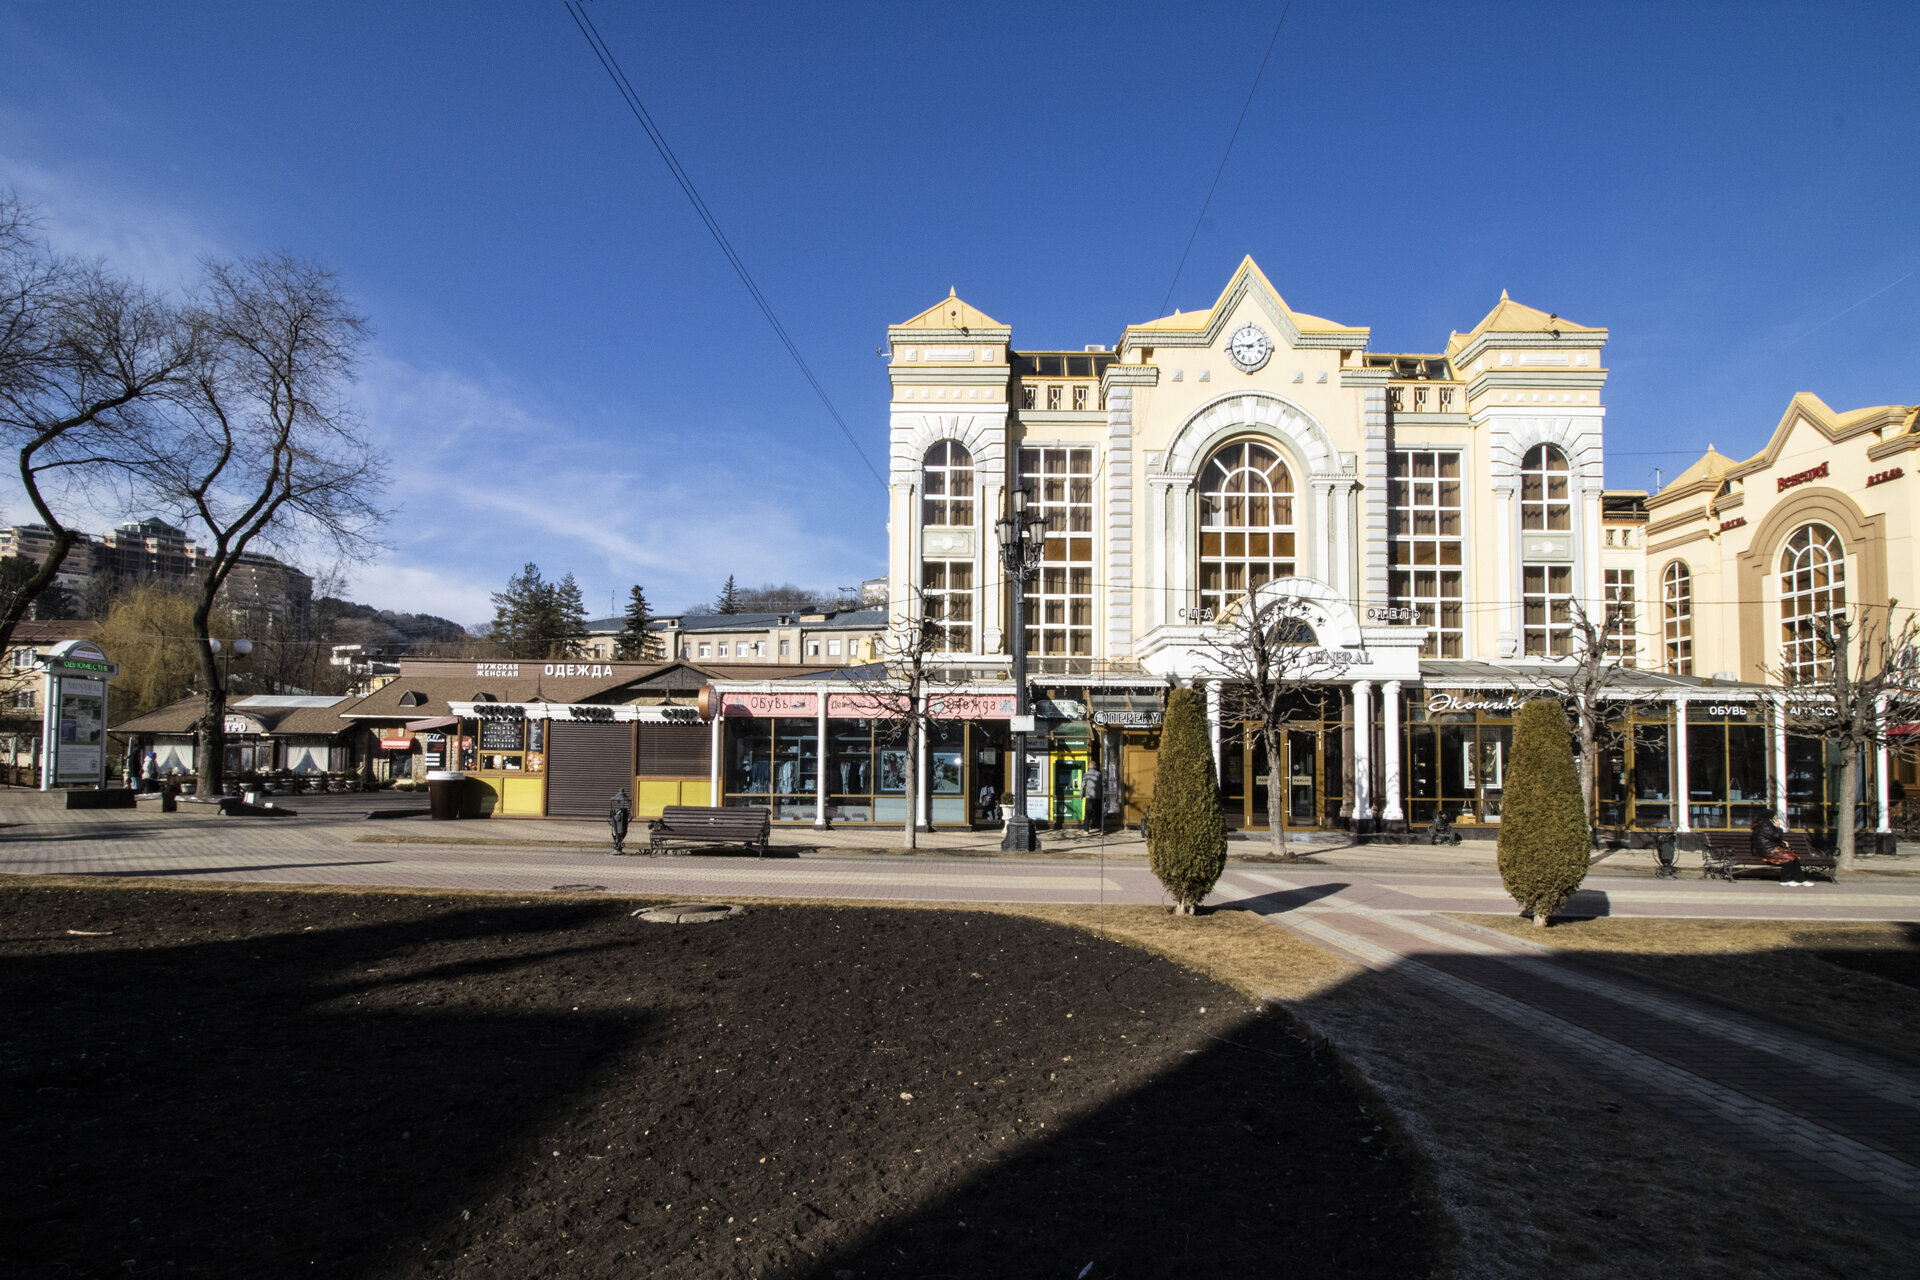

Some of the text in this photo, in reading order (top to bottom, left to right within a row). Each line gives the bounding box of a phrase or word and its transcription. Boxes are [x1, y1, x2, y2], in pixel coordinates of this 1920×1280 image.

[1178, 608, 1214, 619] СПА
[1367, 608, 1421, 619] ОТЕЛЬ
[544, 664, 613, 678] ОДЕЖДА
[1709, 706, 1748, 716] ОБУВЬ
